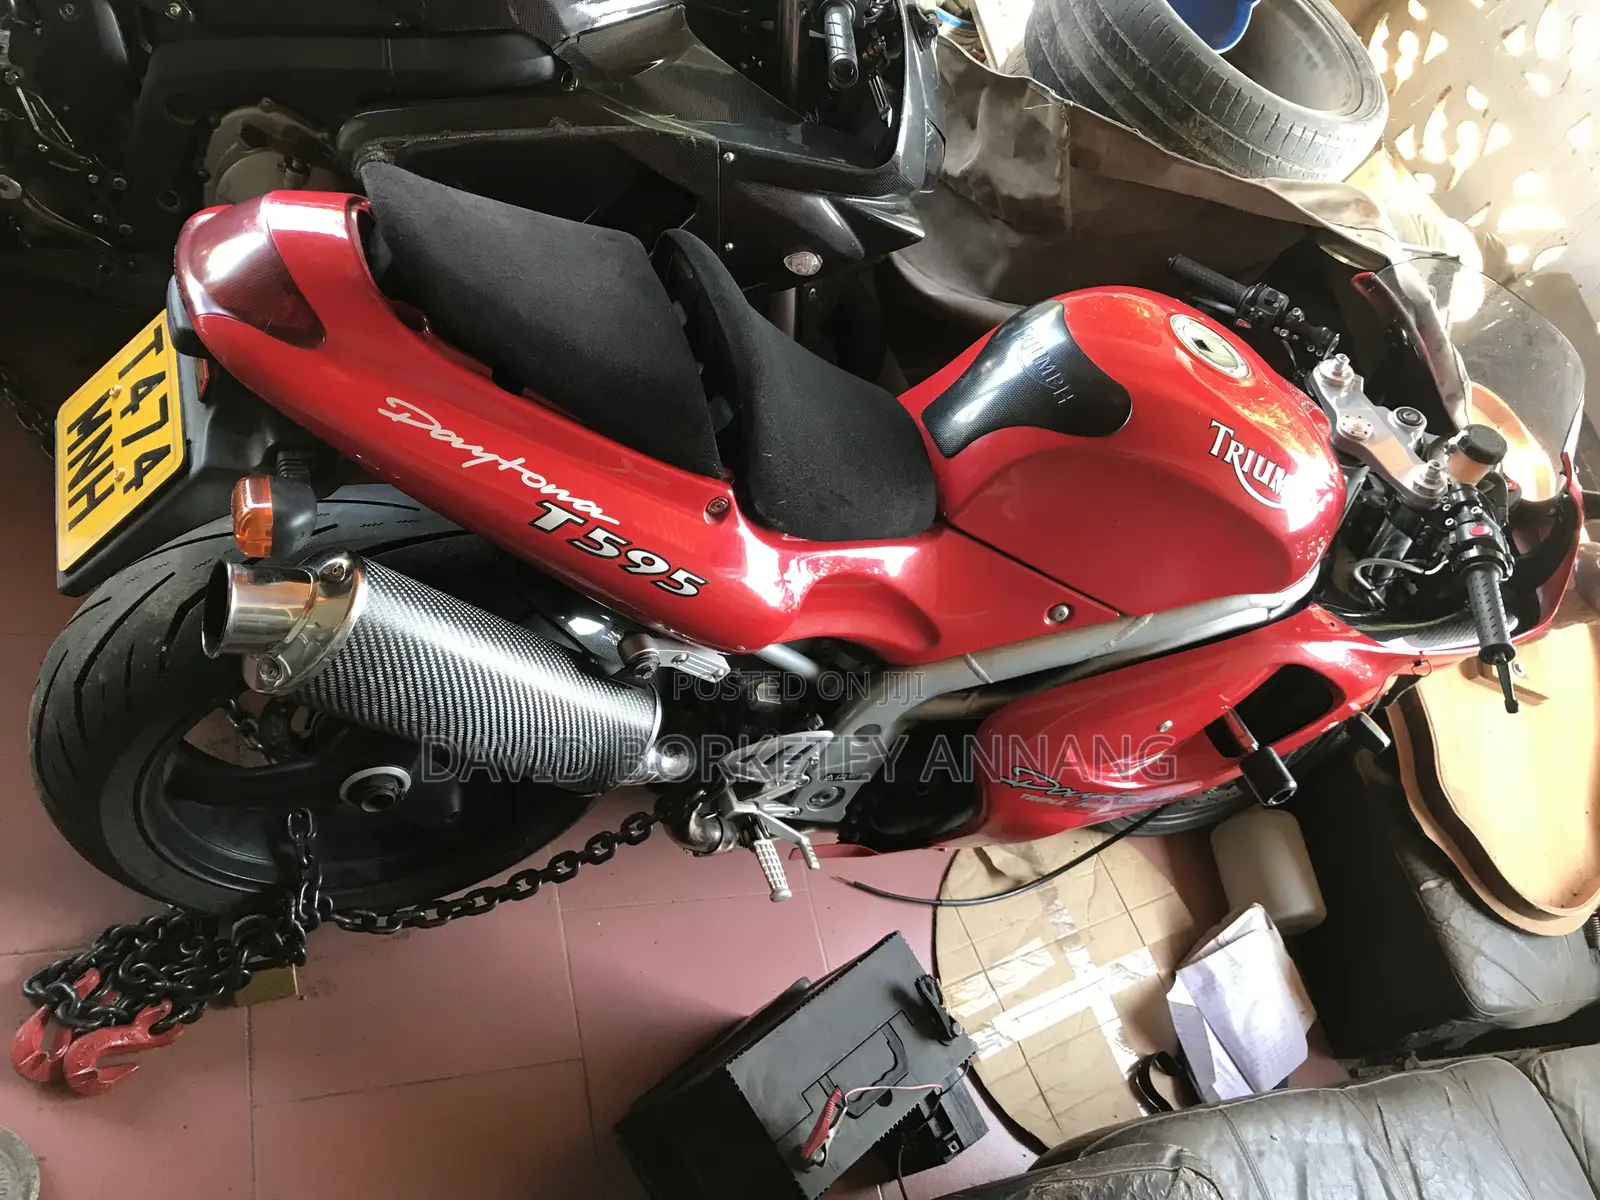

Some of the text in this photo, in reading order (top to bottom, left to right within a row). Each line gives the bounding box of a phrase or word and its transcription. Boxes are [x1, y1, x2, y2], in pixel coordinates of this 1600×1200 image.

[66, 387, 116, 533] MNH
[117, 323, 172, 496] T474
[377, 396, 621, 525] Daytona
[1207, 417, 1292, 509] TRIUM
[527, 499, 710, 598] T595
